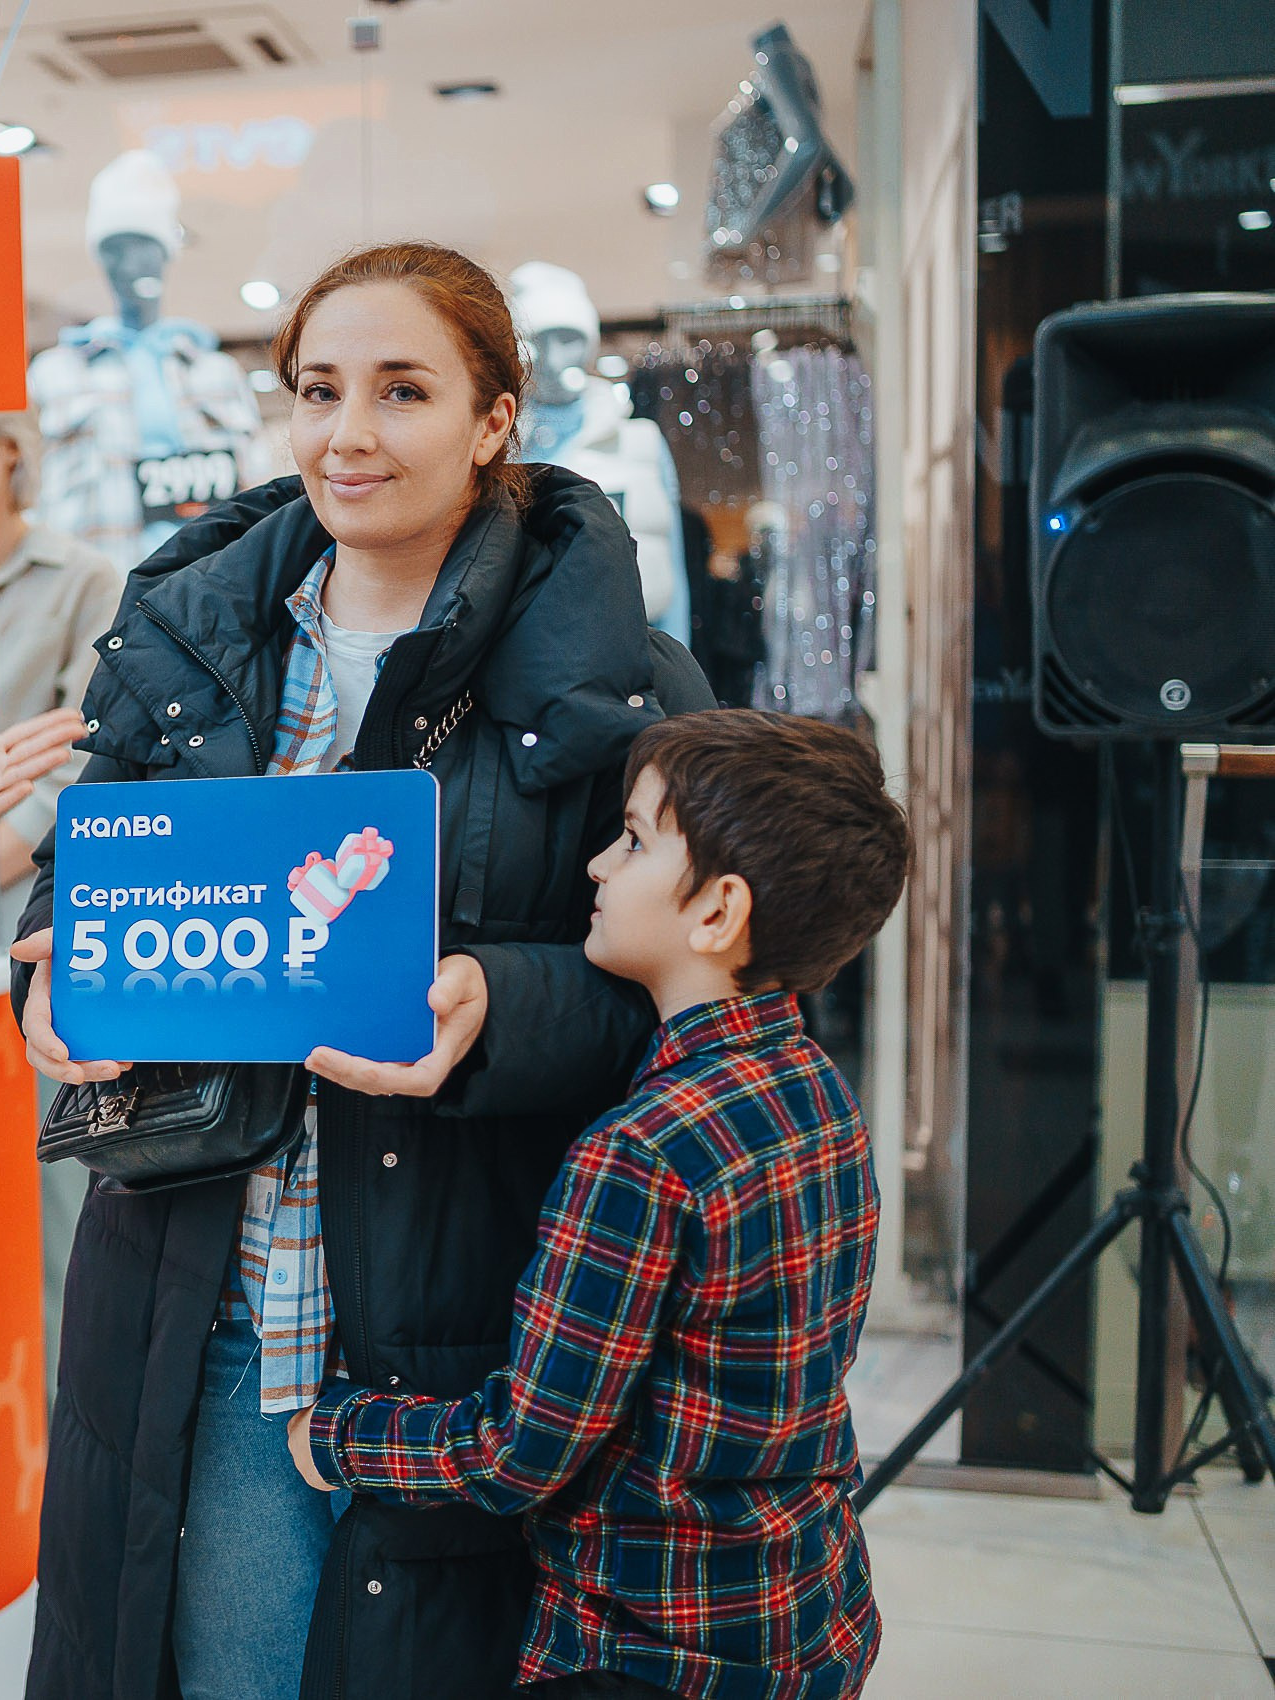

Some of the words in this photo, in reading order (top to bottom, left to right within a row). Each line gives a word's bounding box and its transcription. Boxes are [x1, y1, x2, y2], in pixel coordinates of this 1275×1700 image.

[69, 881, 267, 912] Сертификат
[68, 920, 108, 971] 5
[123, 917, 269, 971] 000
